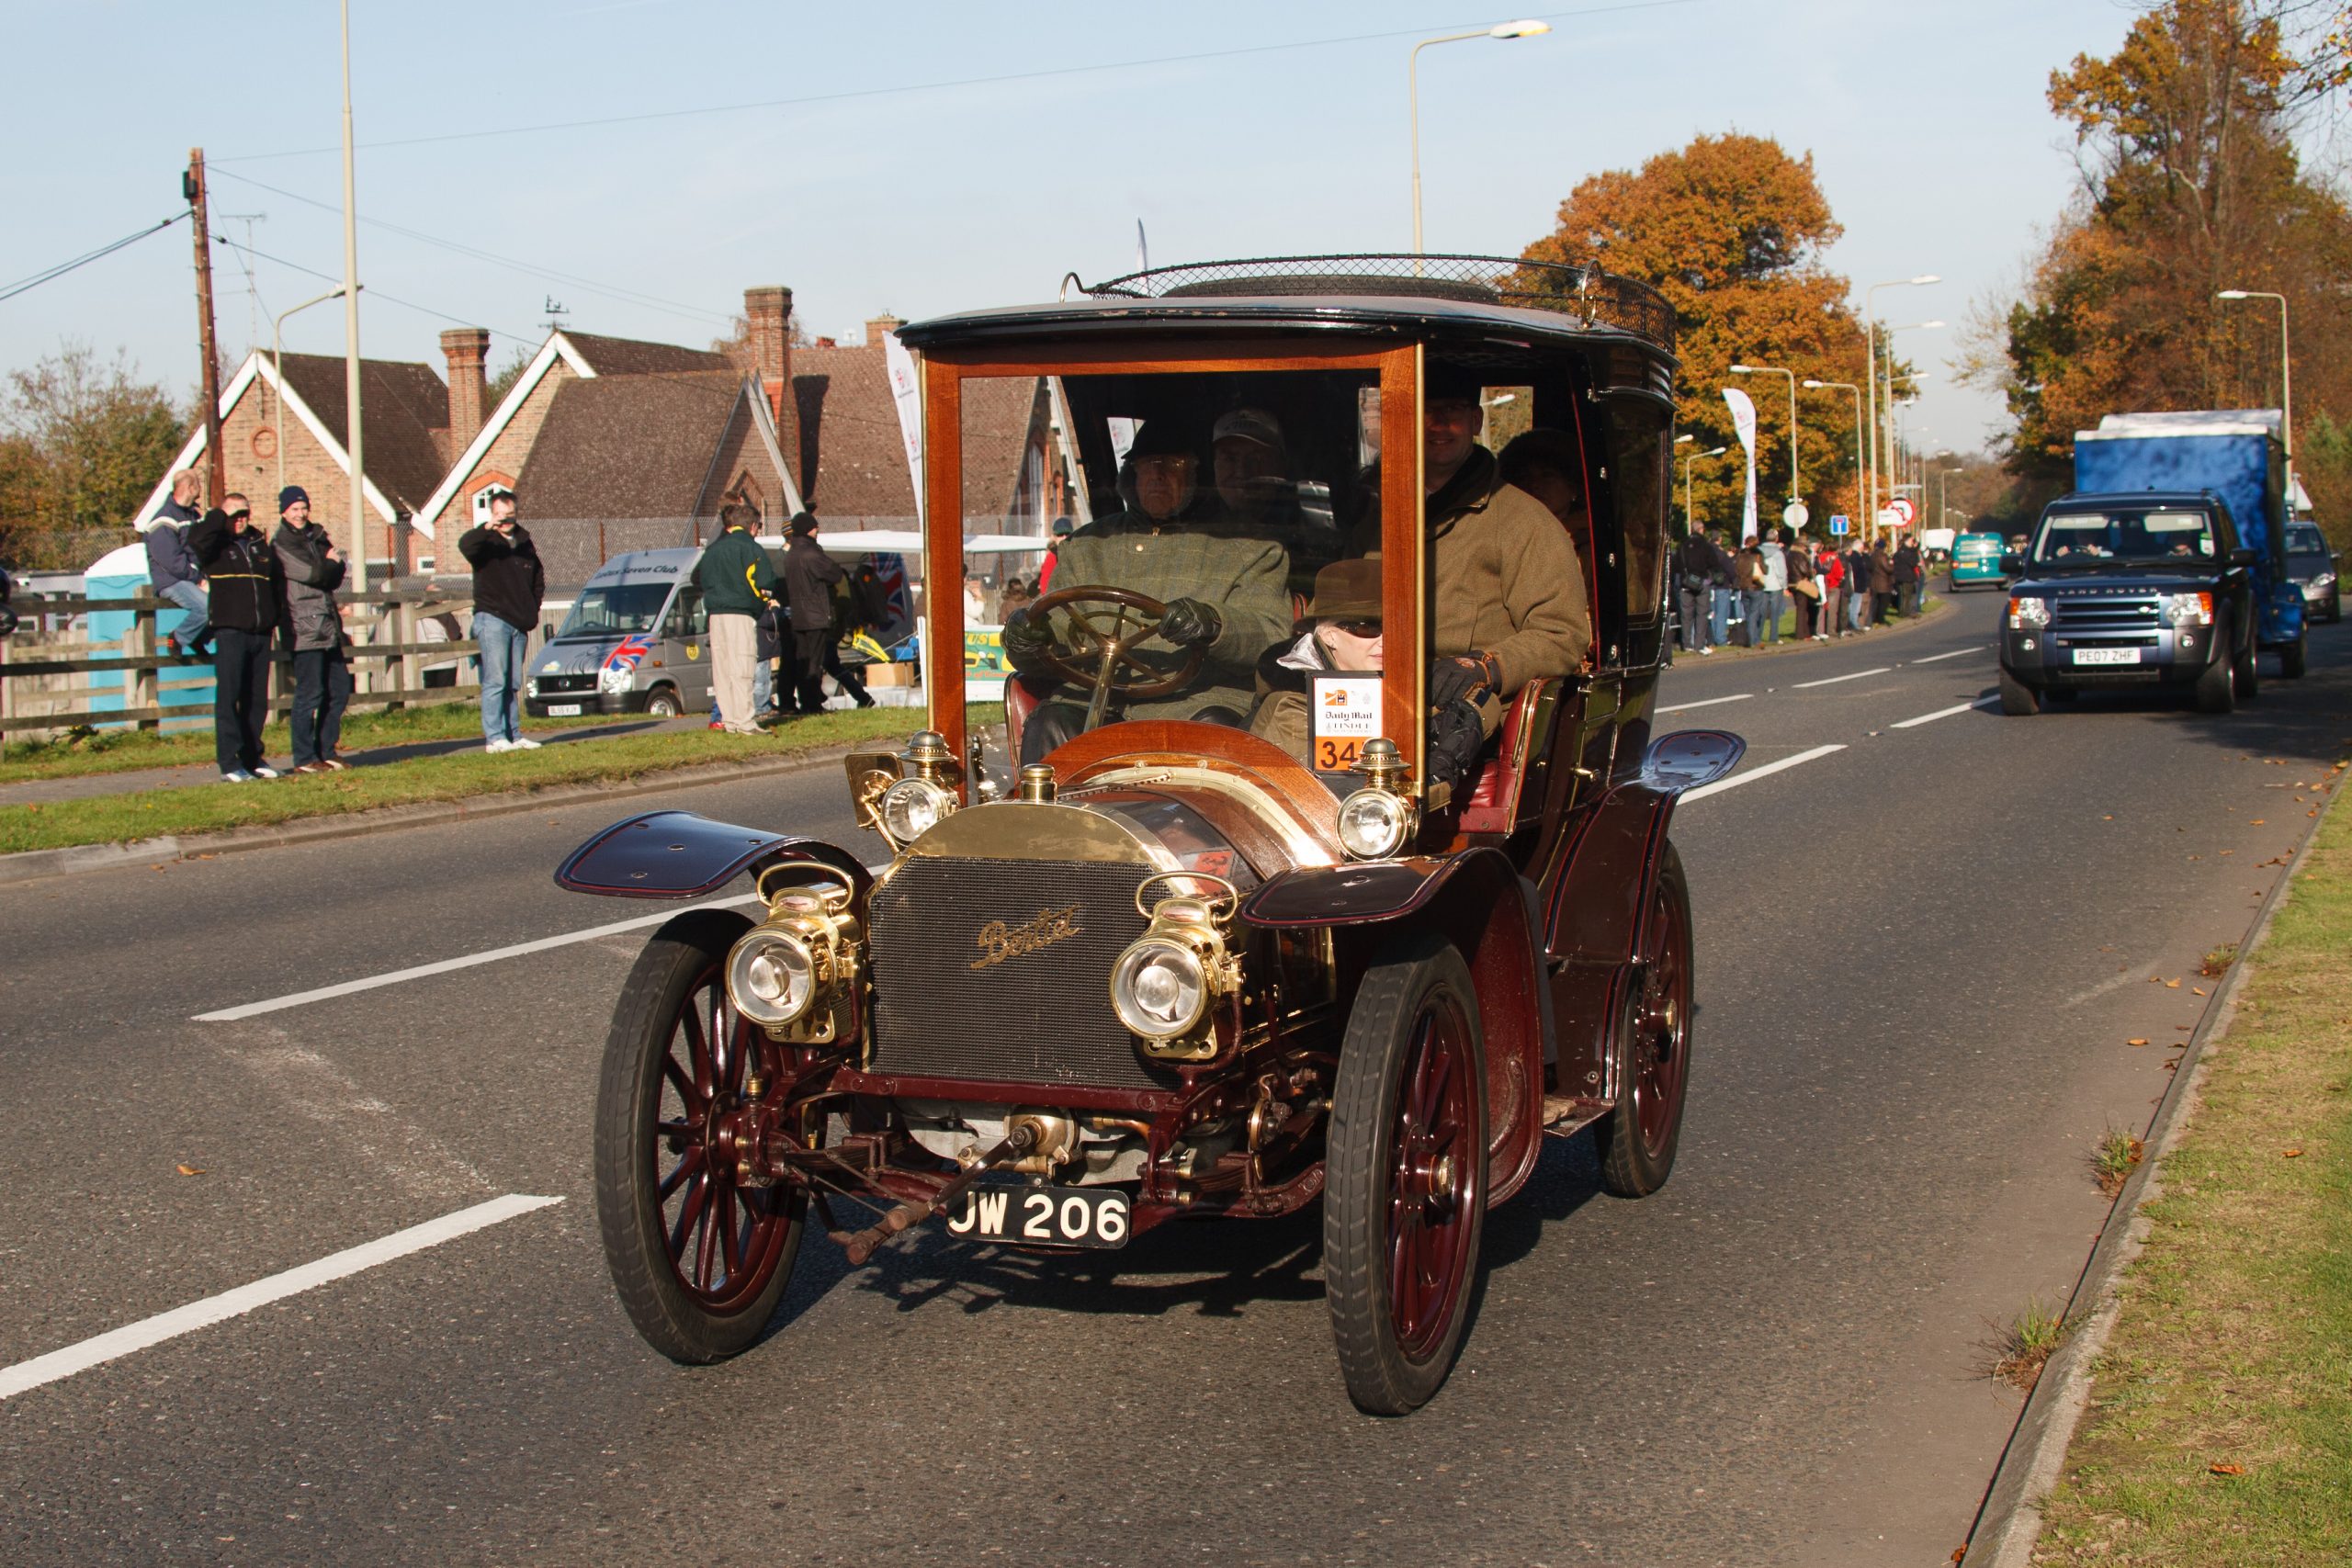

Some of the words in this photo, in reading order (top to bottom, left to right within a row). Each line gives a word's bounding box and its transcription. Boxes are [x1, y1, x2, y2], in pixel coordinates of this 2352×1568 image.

[621, 566, 652, 574] Seven
[653, 564, 679, 574] Club
[2105, 587, 2158, 595] ROVER
[965, 632, 988, 646] US
[2078, 650, 2109, 662] PE07
[2111, 649, 2134, 661] ZHF
[1325, 711, 1350, 721] Daily
[1351, 711, 1373, 719] Mail
[1320, 740, 1364, 769] 34
[947, 1190, 1008, 1235] JW
[1023, 1193, 1127, 1242] 206
